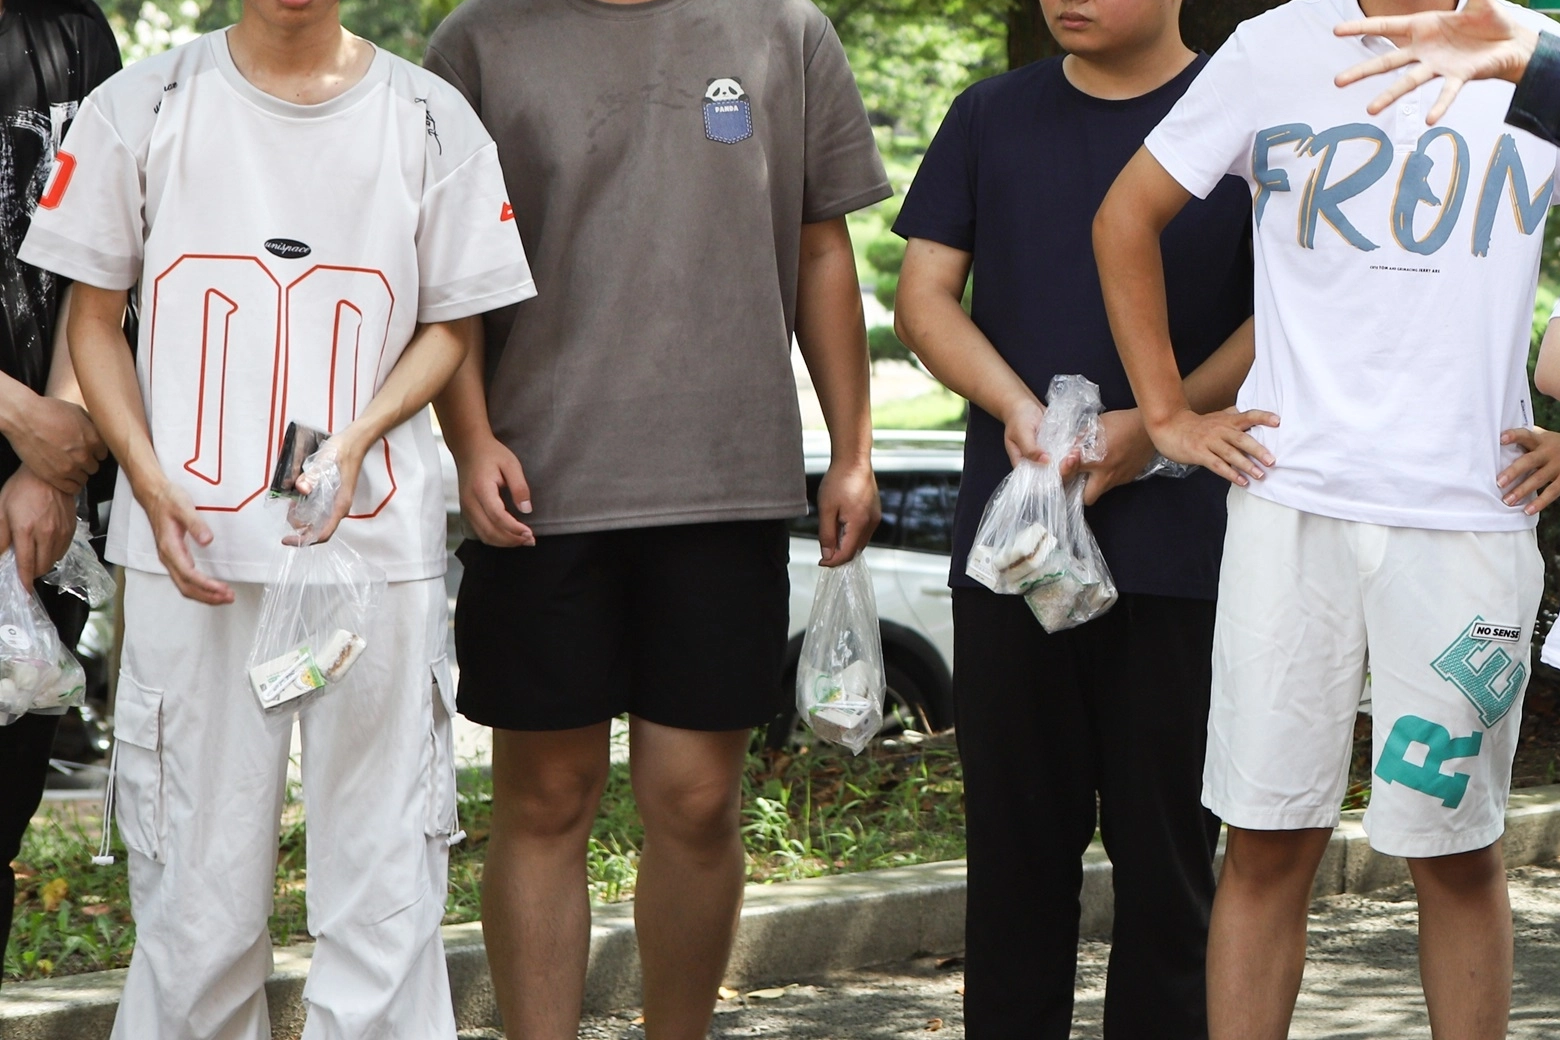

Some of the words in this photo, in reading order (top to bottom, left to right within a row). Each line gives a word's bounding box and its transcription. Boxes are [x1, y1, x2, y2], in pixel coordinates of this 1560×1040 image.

[714, 105, 739, 113] PANDA
[265, 241, 310, 255] unispace
[1476, 625, 1491, 636] NO
[1493, 627, 1520, 639] SENSE
